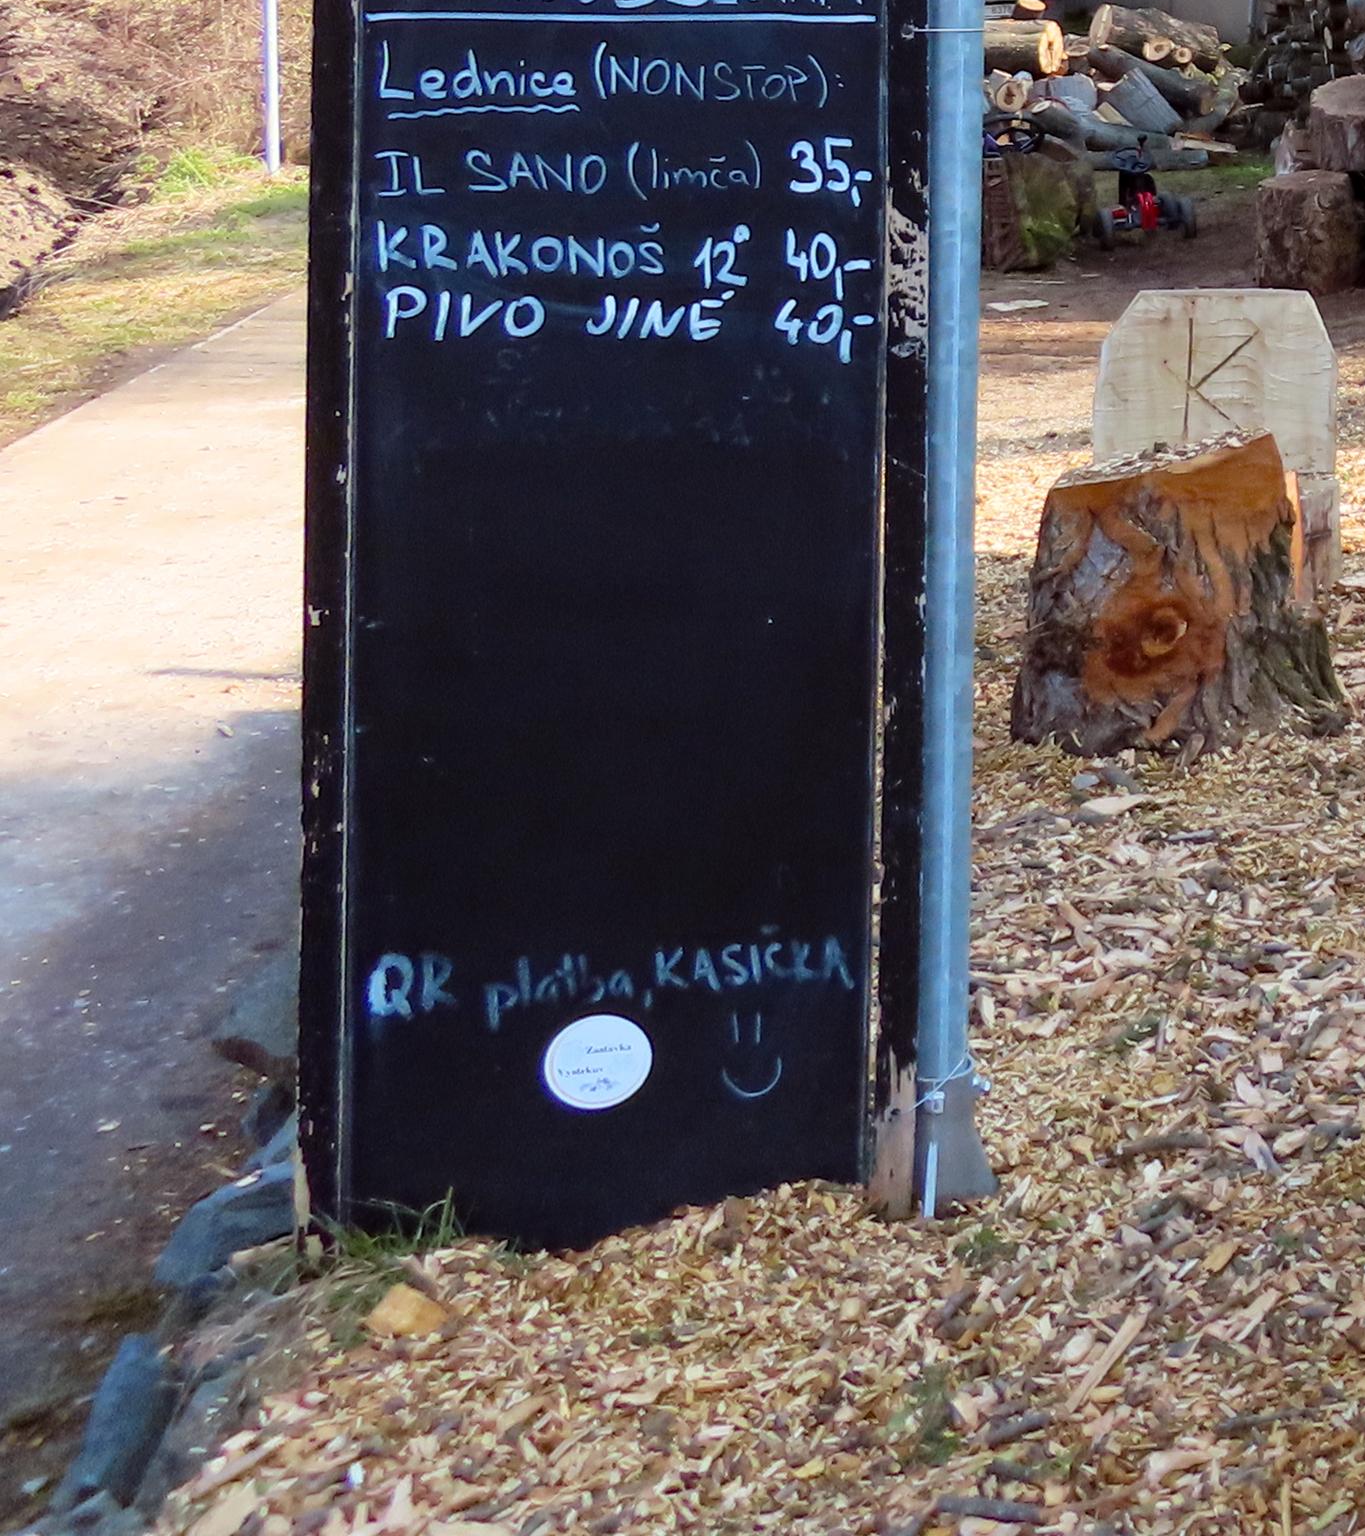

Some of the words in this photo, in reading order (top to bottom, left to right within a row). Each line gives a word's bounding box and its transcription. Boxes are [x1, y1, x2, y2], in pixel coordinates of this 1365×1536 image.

[378, 40, 578, 101] Lednice
[375, 150, 445, 197] IL
[465, 148, 607, 195] SANO
[376, 220, 665, 278] KRAKONOŠ
[383, 285, 546, 342] PIVO
[586, 289, 735, 342] JINÉ
[368, 951, 456, 1021] QR
